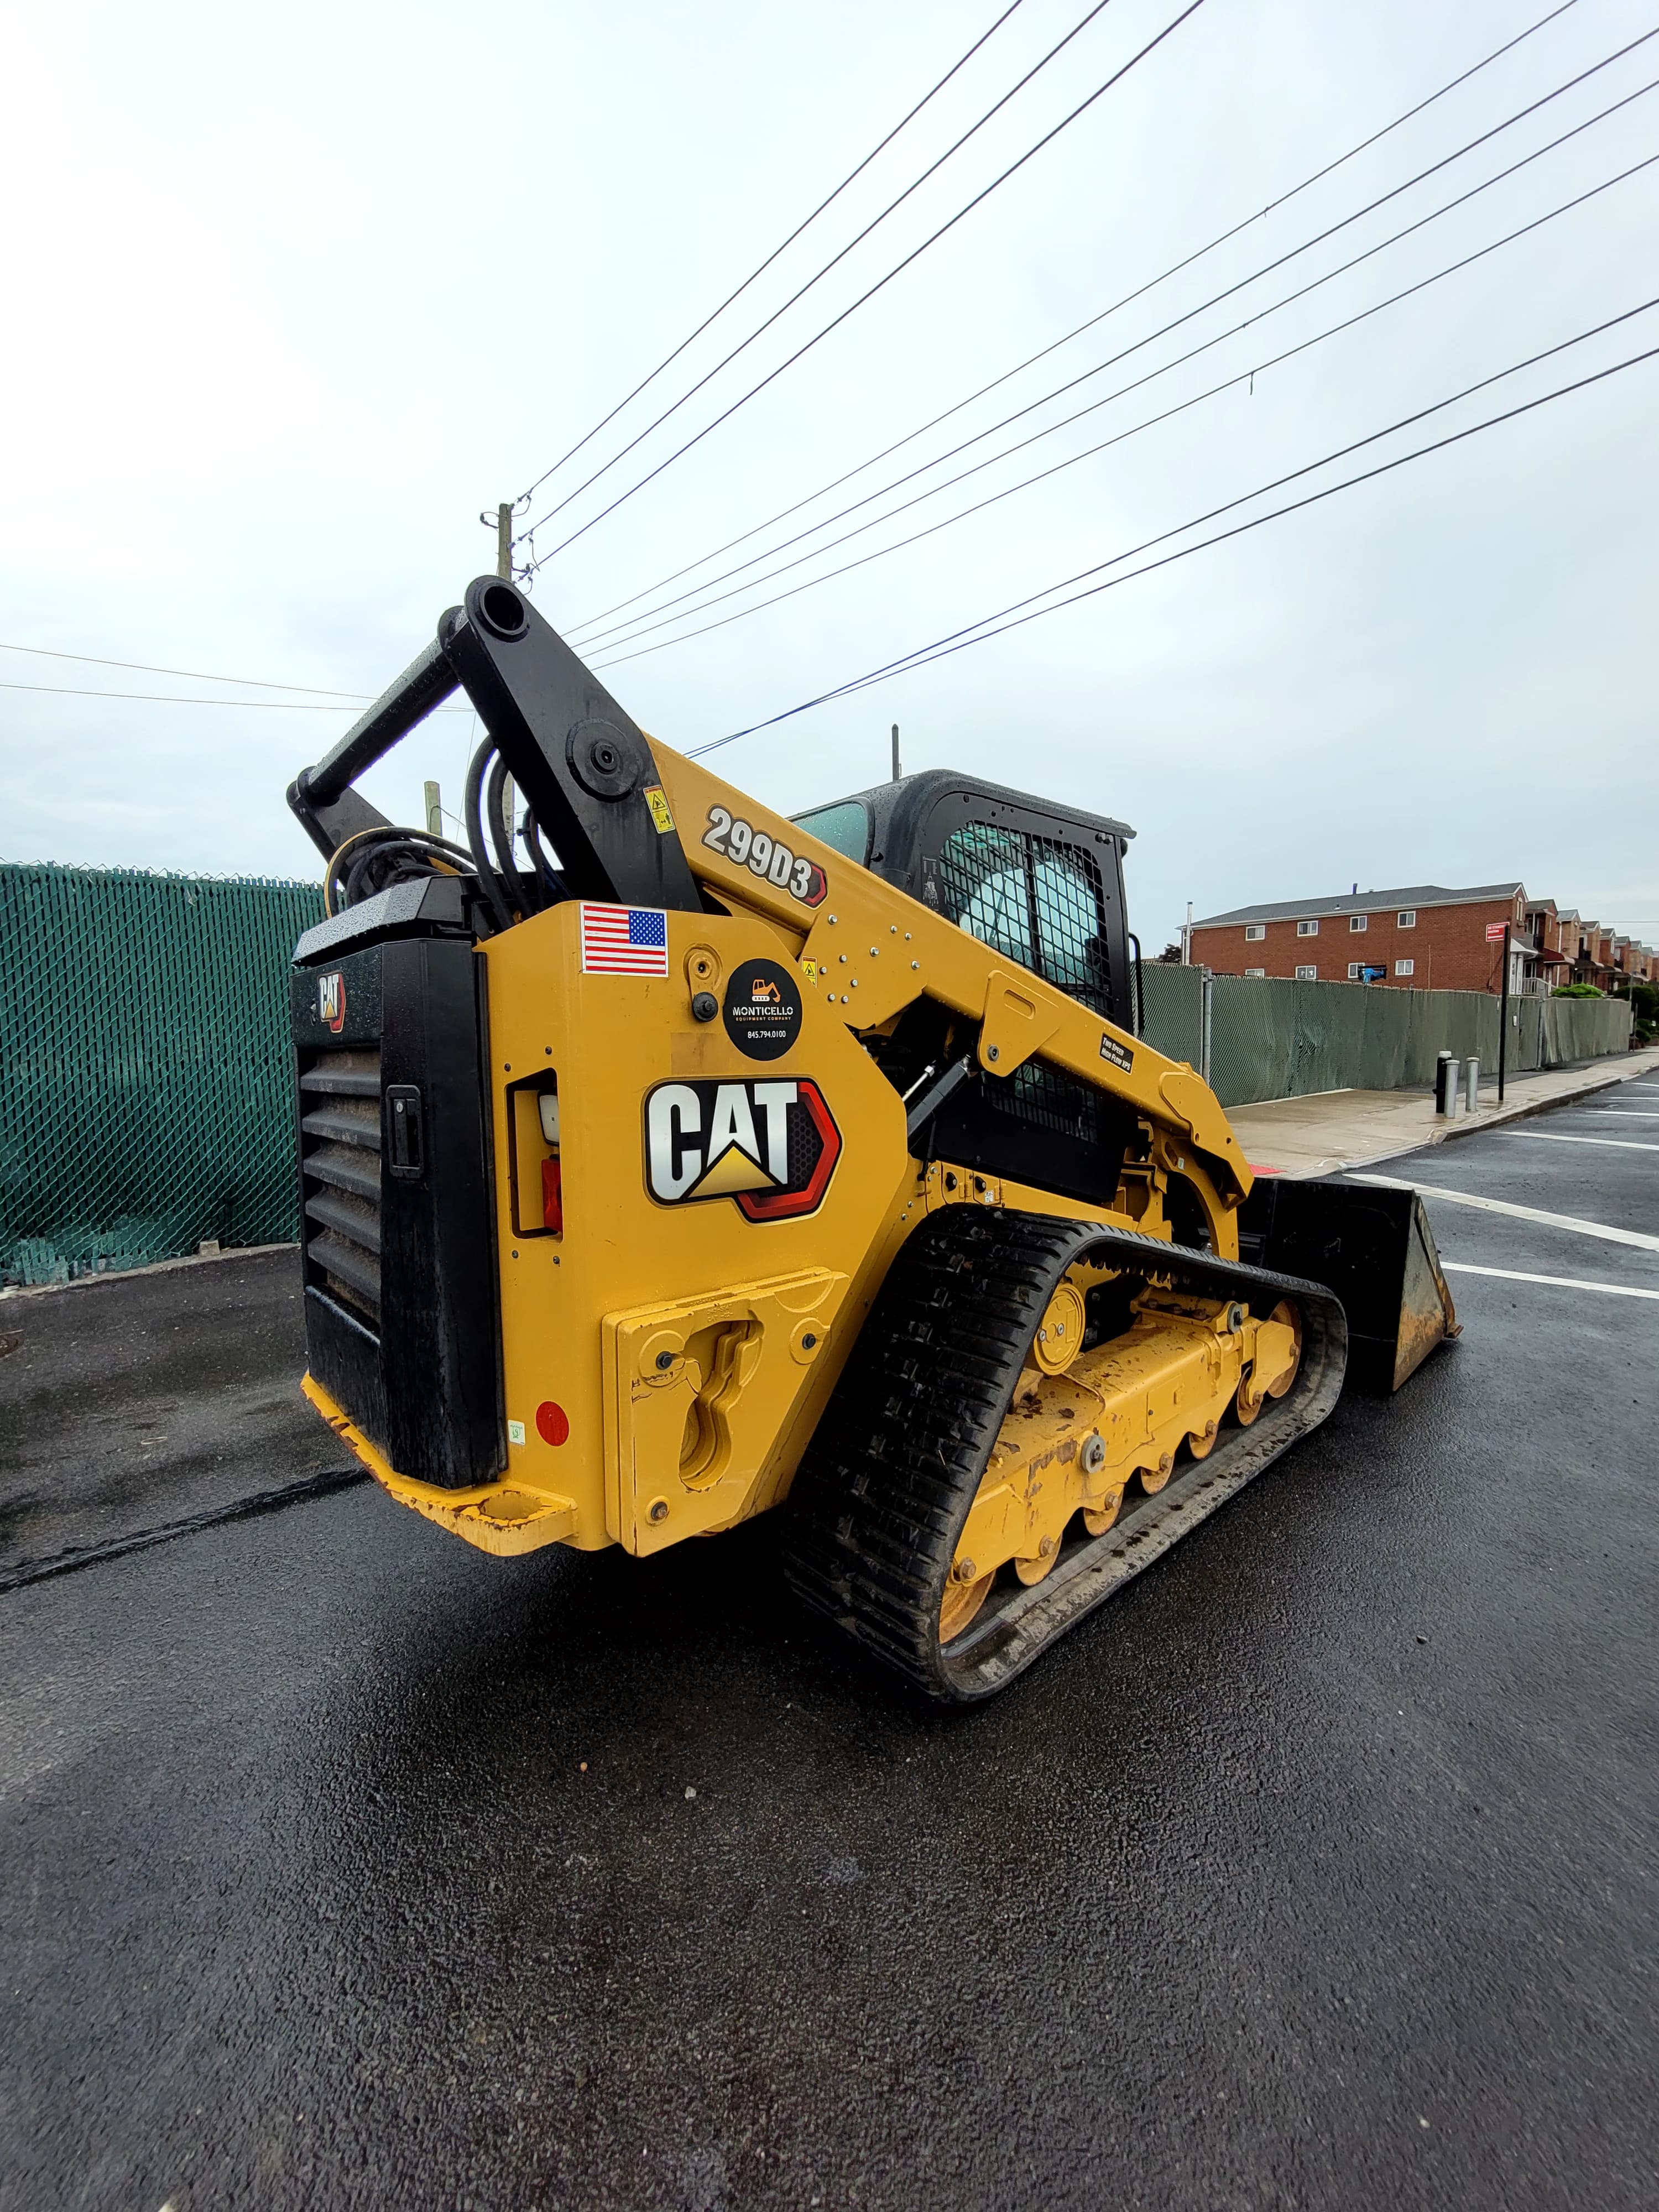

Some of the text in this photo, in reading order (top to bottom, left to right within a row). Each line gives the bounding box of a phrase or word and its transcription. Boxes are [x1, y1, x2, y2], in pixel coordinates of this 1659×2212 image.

[705, 808, 812, 898] 299D3
[319, 974, 339, 1019] CAT
[733, 1006, 794, 1016] MONTICELLO
[748, 1030, 786, 1039] 845.794.0100
[1121, 1060, 1131, 1071] XPS
[649, 1082, 798, 1200] CAT
